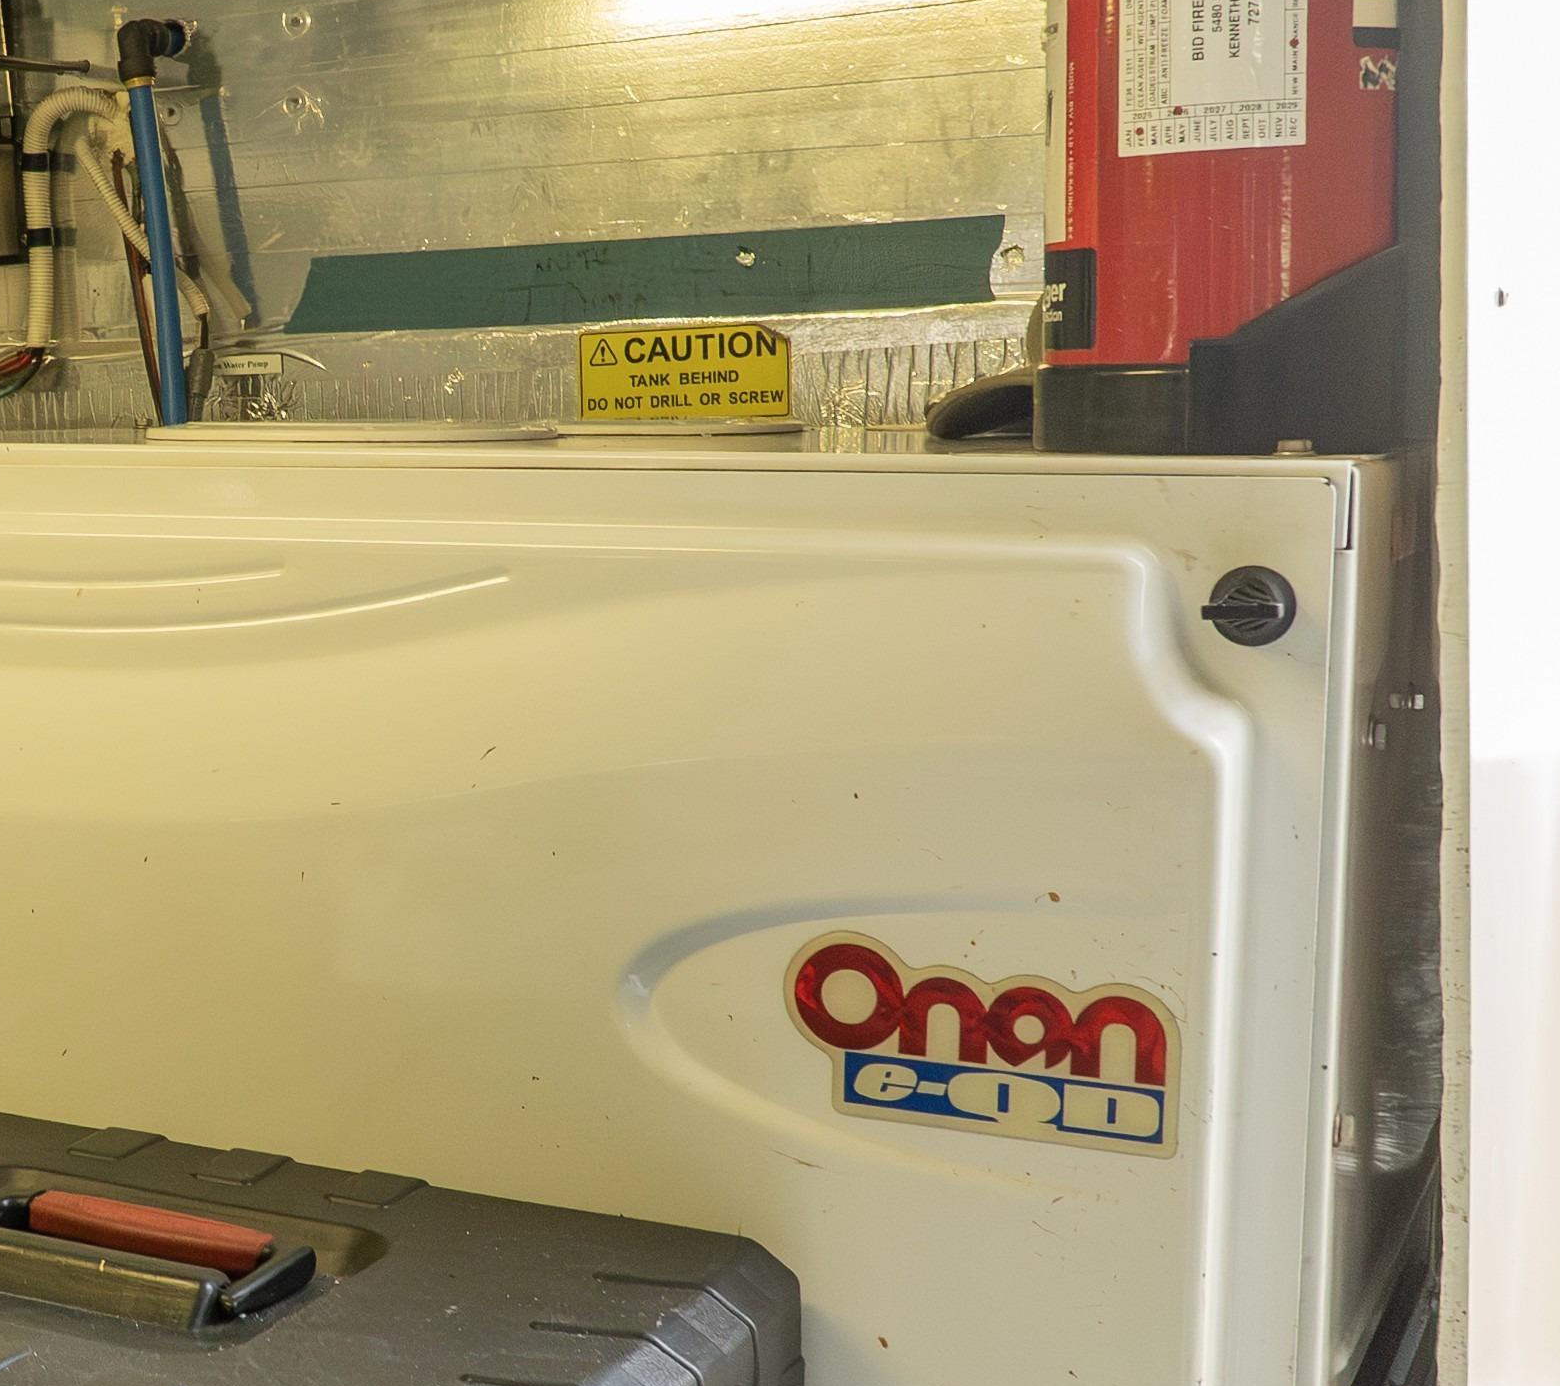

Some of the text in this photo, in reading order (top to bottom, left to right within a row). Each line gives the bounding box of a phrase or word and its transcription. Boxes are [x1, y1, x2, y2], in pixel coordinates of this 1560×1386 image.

[1192, 0, 1204, 32] FIRE
[1212, 5, 1223, 33] 5480
[1192, 37, 1204, 61] BID
[624, 332, 777, 364] CAUTION
[629, 370, 739, 388] TANK BEHIND
[587, 390, 784, 411] DO NOT DRILL OR SCREW
[853, 1062, 1161, 1139] e-QD
